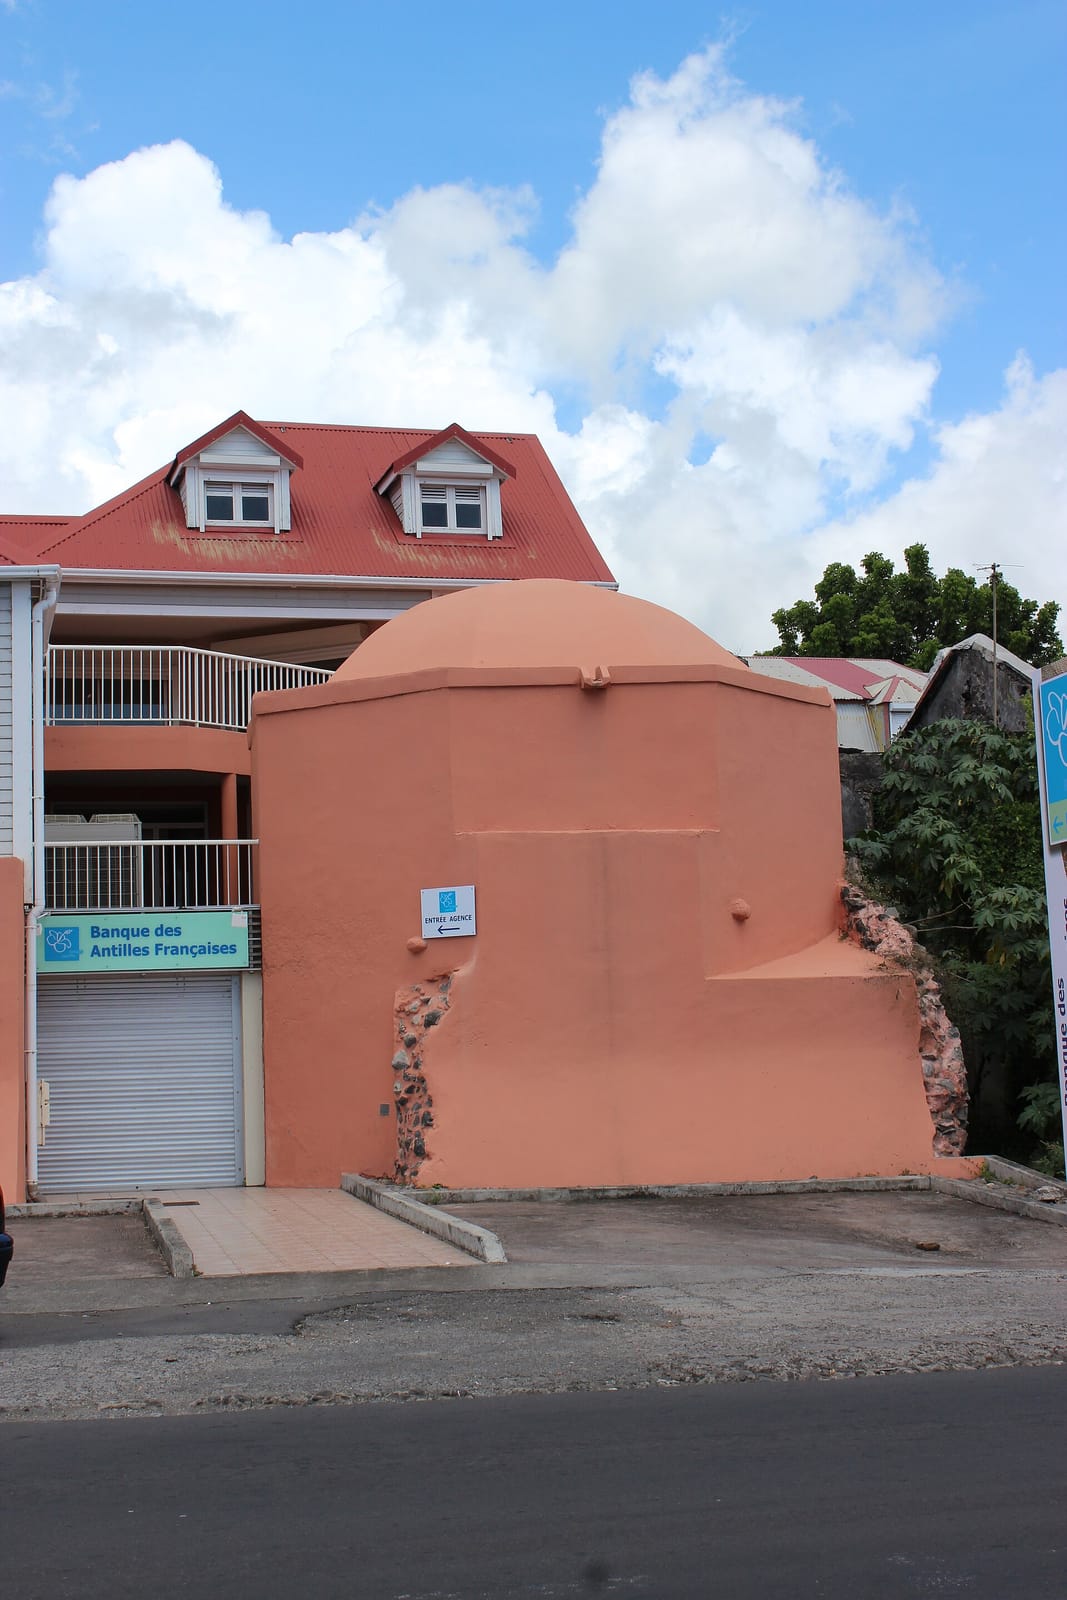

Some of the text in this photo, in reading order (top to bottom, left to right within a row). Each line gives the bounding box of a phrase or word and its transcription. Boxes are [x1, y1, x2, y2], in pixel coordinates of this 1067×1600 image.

[449, 914, 472, 922] AGENCE
[90, 924, 182, 940] Banque des
[90, 942, 237, 958] Antilles Françaises
[1057, 977, 1065, 1016] des
